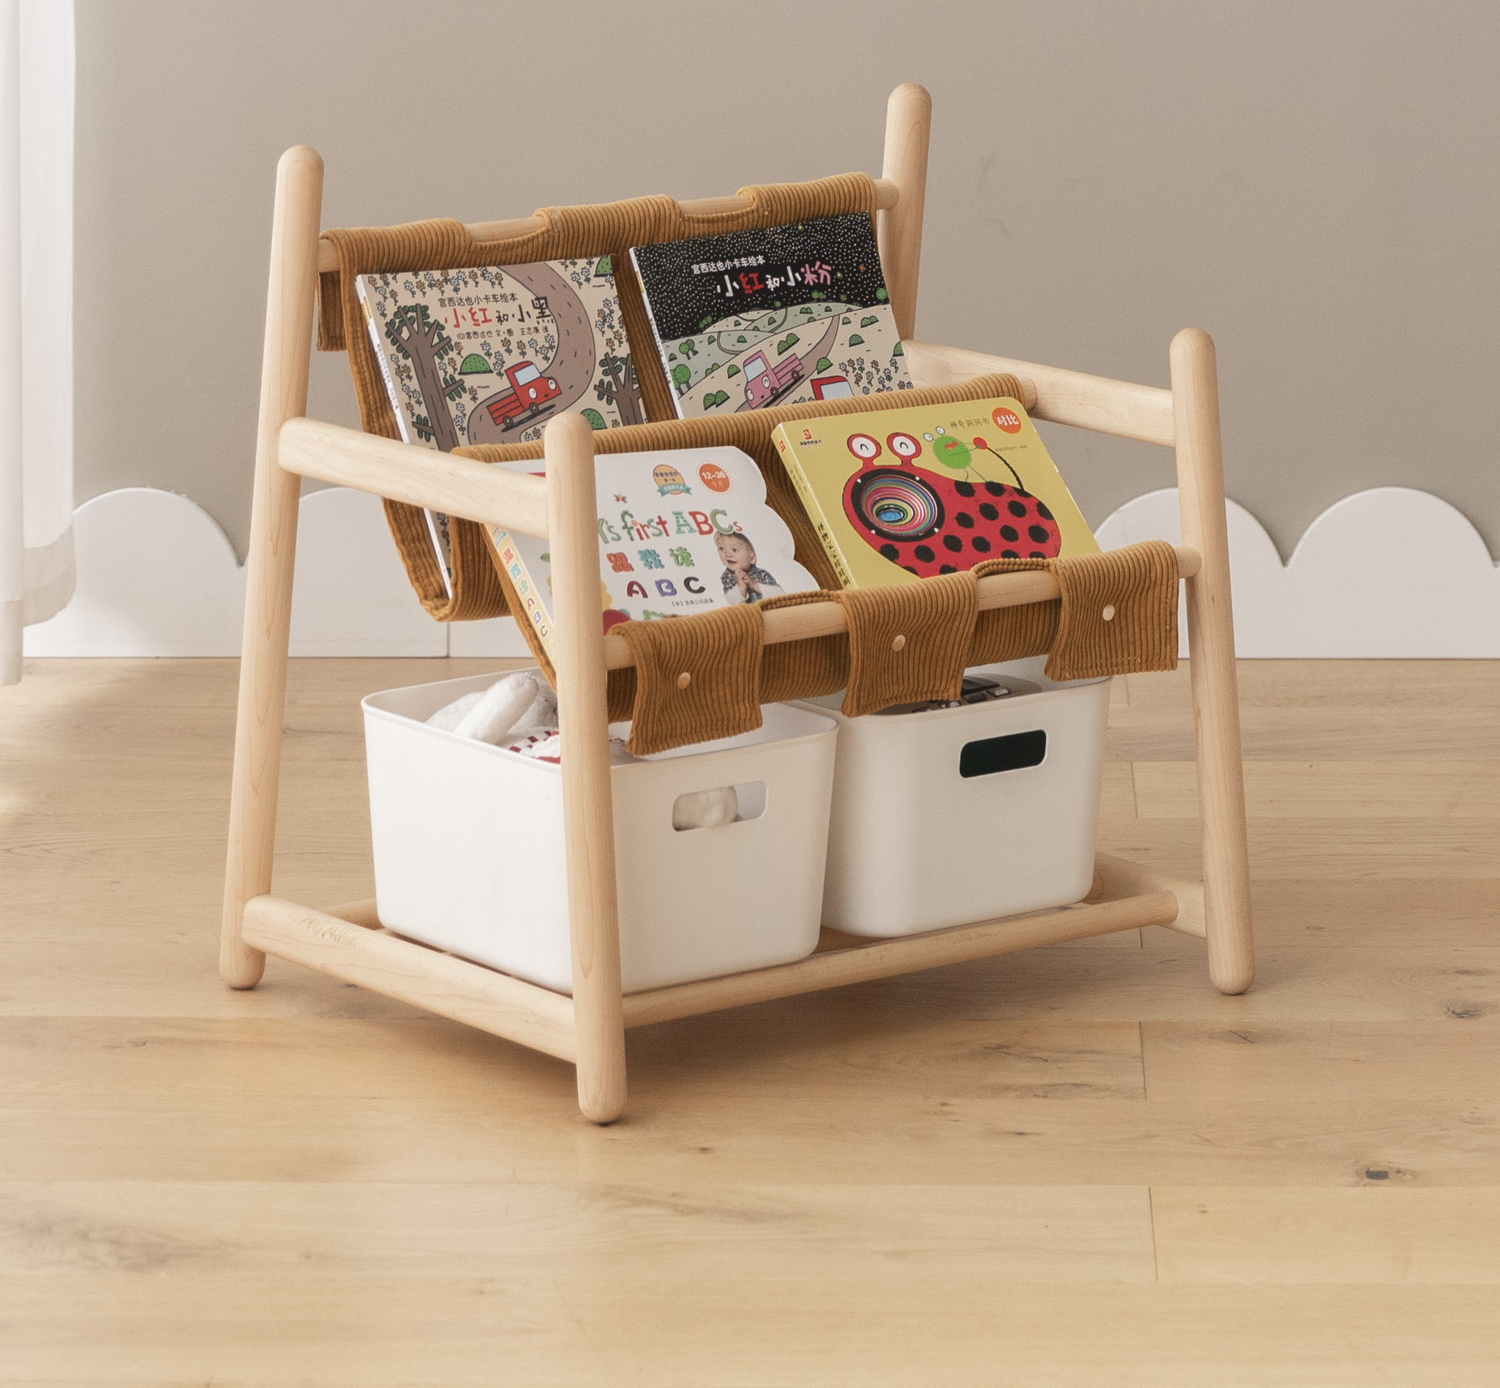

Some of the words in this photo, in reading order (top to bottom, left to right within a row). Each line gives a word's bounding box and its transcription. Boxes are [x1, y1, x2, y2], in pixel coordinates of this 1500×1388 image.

[716, 261, 832, 297] 小红和小粉
[445, 296, 552, 328] 小红和小黑
[996, 414, 1019, 426] 对比
[621, 510, 670, 542] first
[671, 508, 743, 536] ABCs
